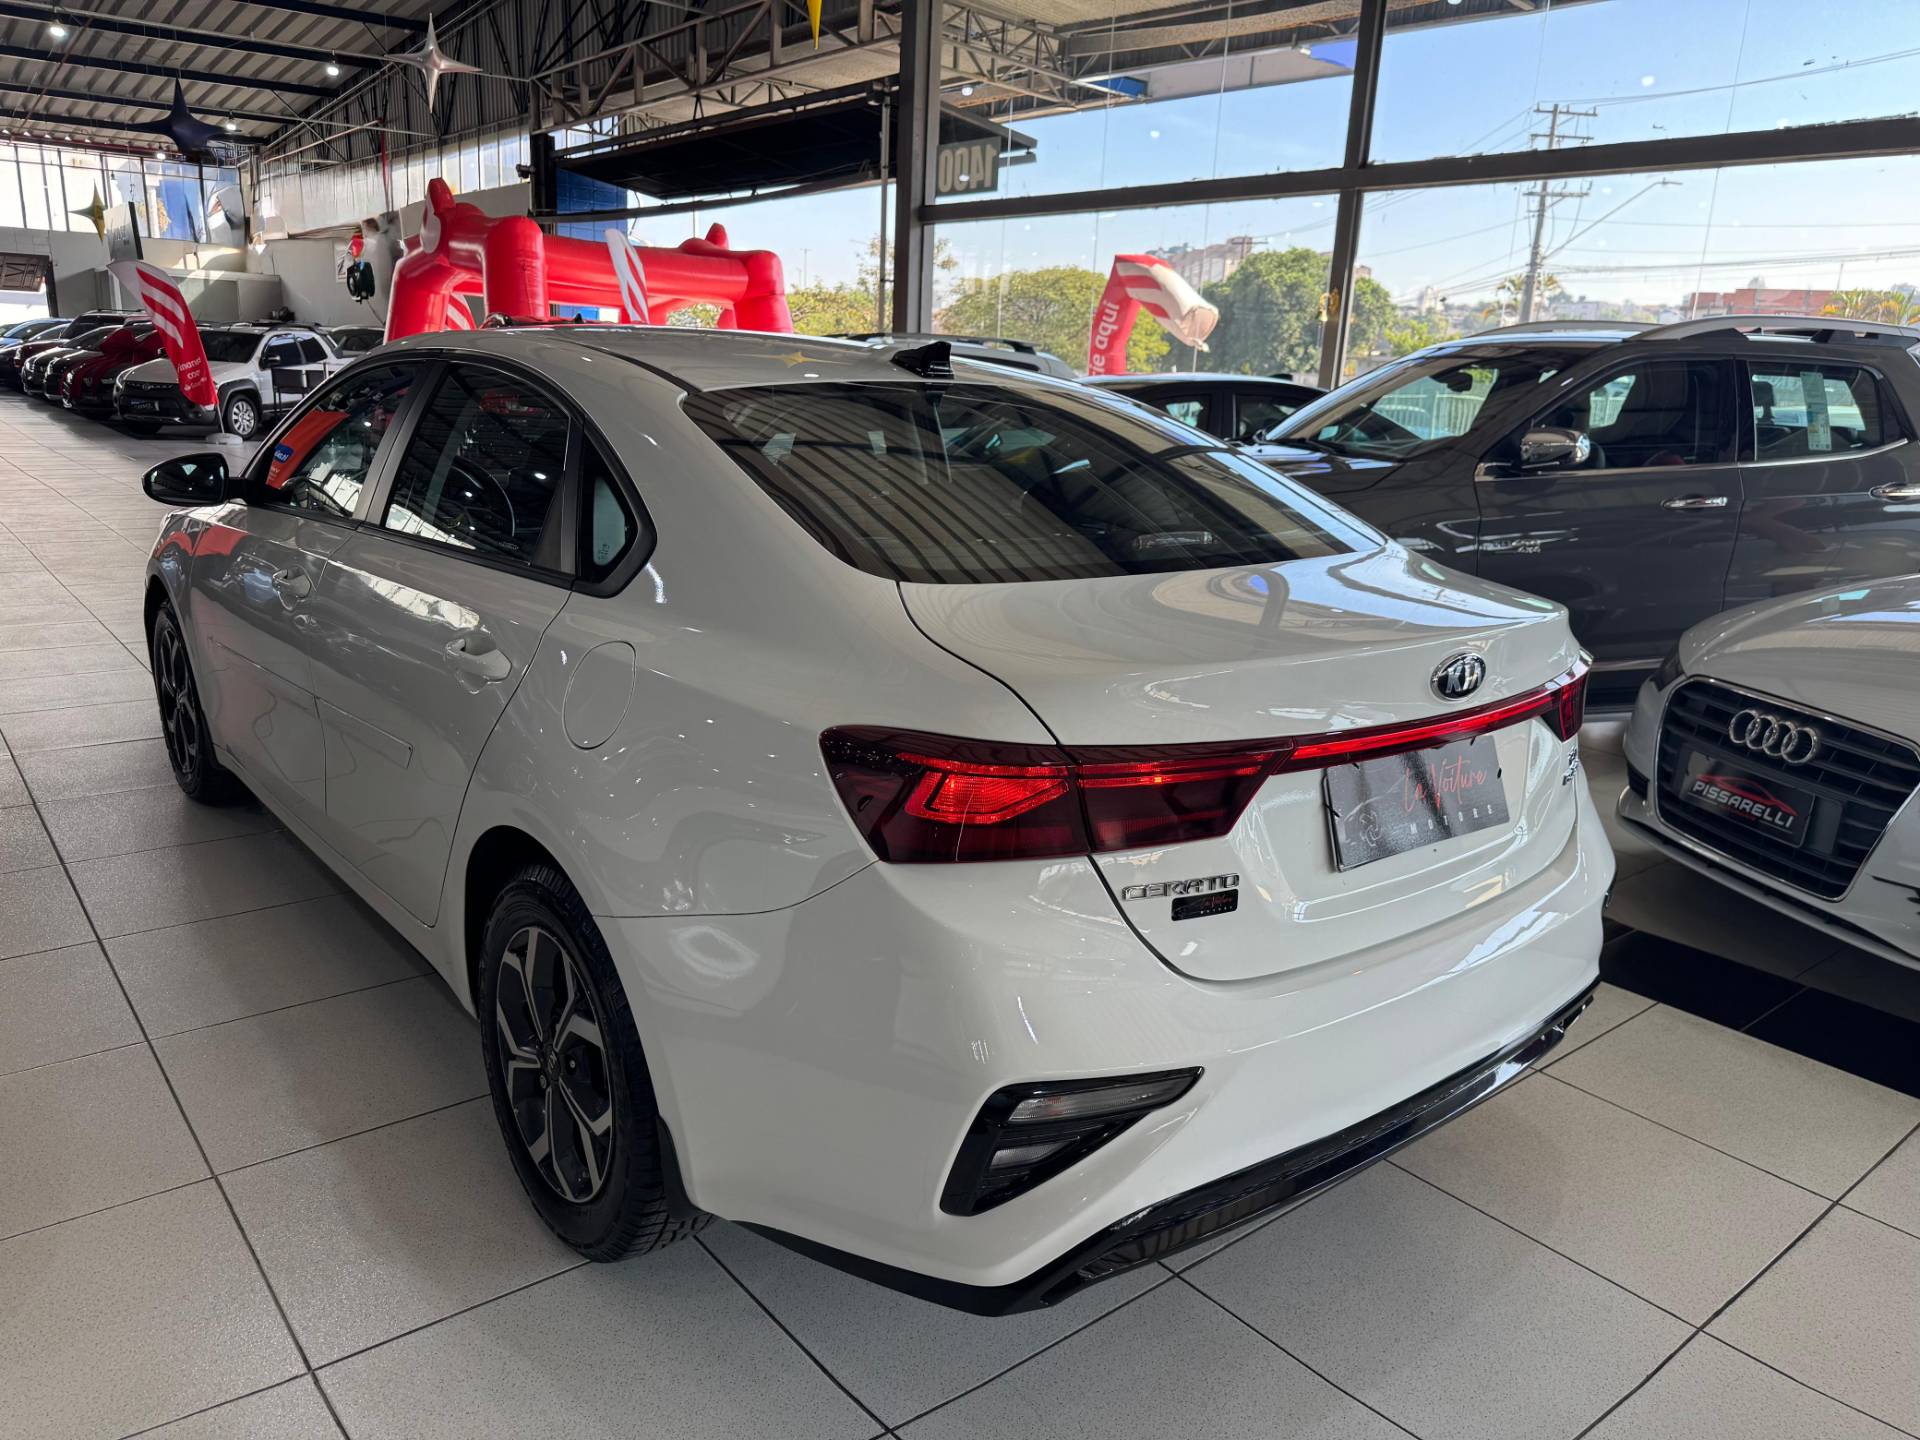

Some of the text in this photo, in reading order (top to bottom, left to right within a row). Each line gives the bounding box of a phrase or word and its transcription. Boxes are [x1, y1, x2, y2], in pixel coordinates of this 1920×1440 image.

[1095, 300, 1120, 350] aqui
[1446, 656, 1482, 693] KIA
[1403, 751, 1488, 815] La Voiture
[1692, 781, 1795, 829] PISSARELLI
[1121, 873, 1240, 901] CERATO
